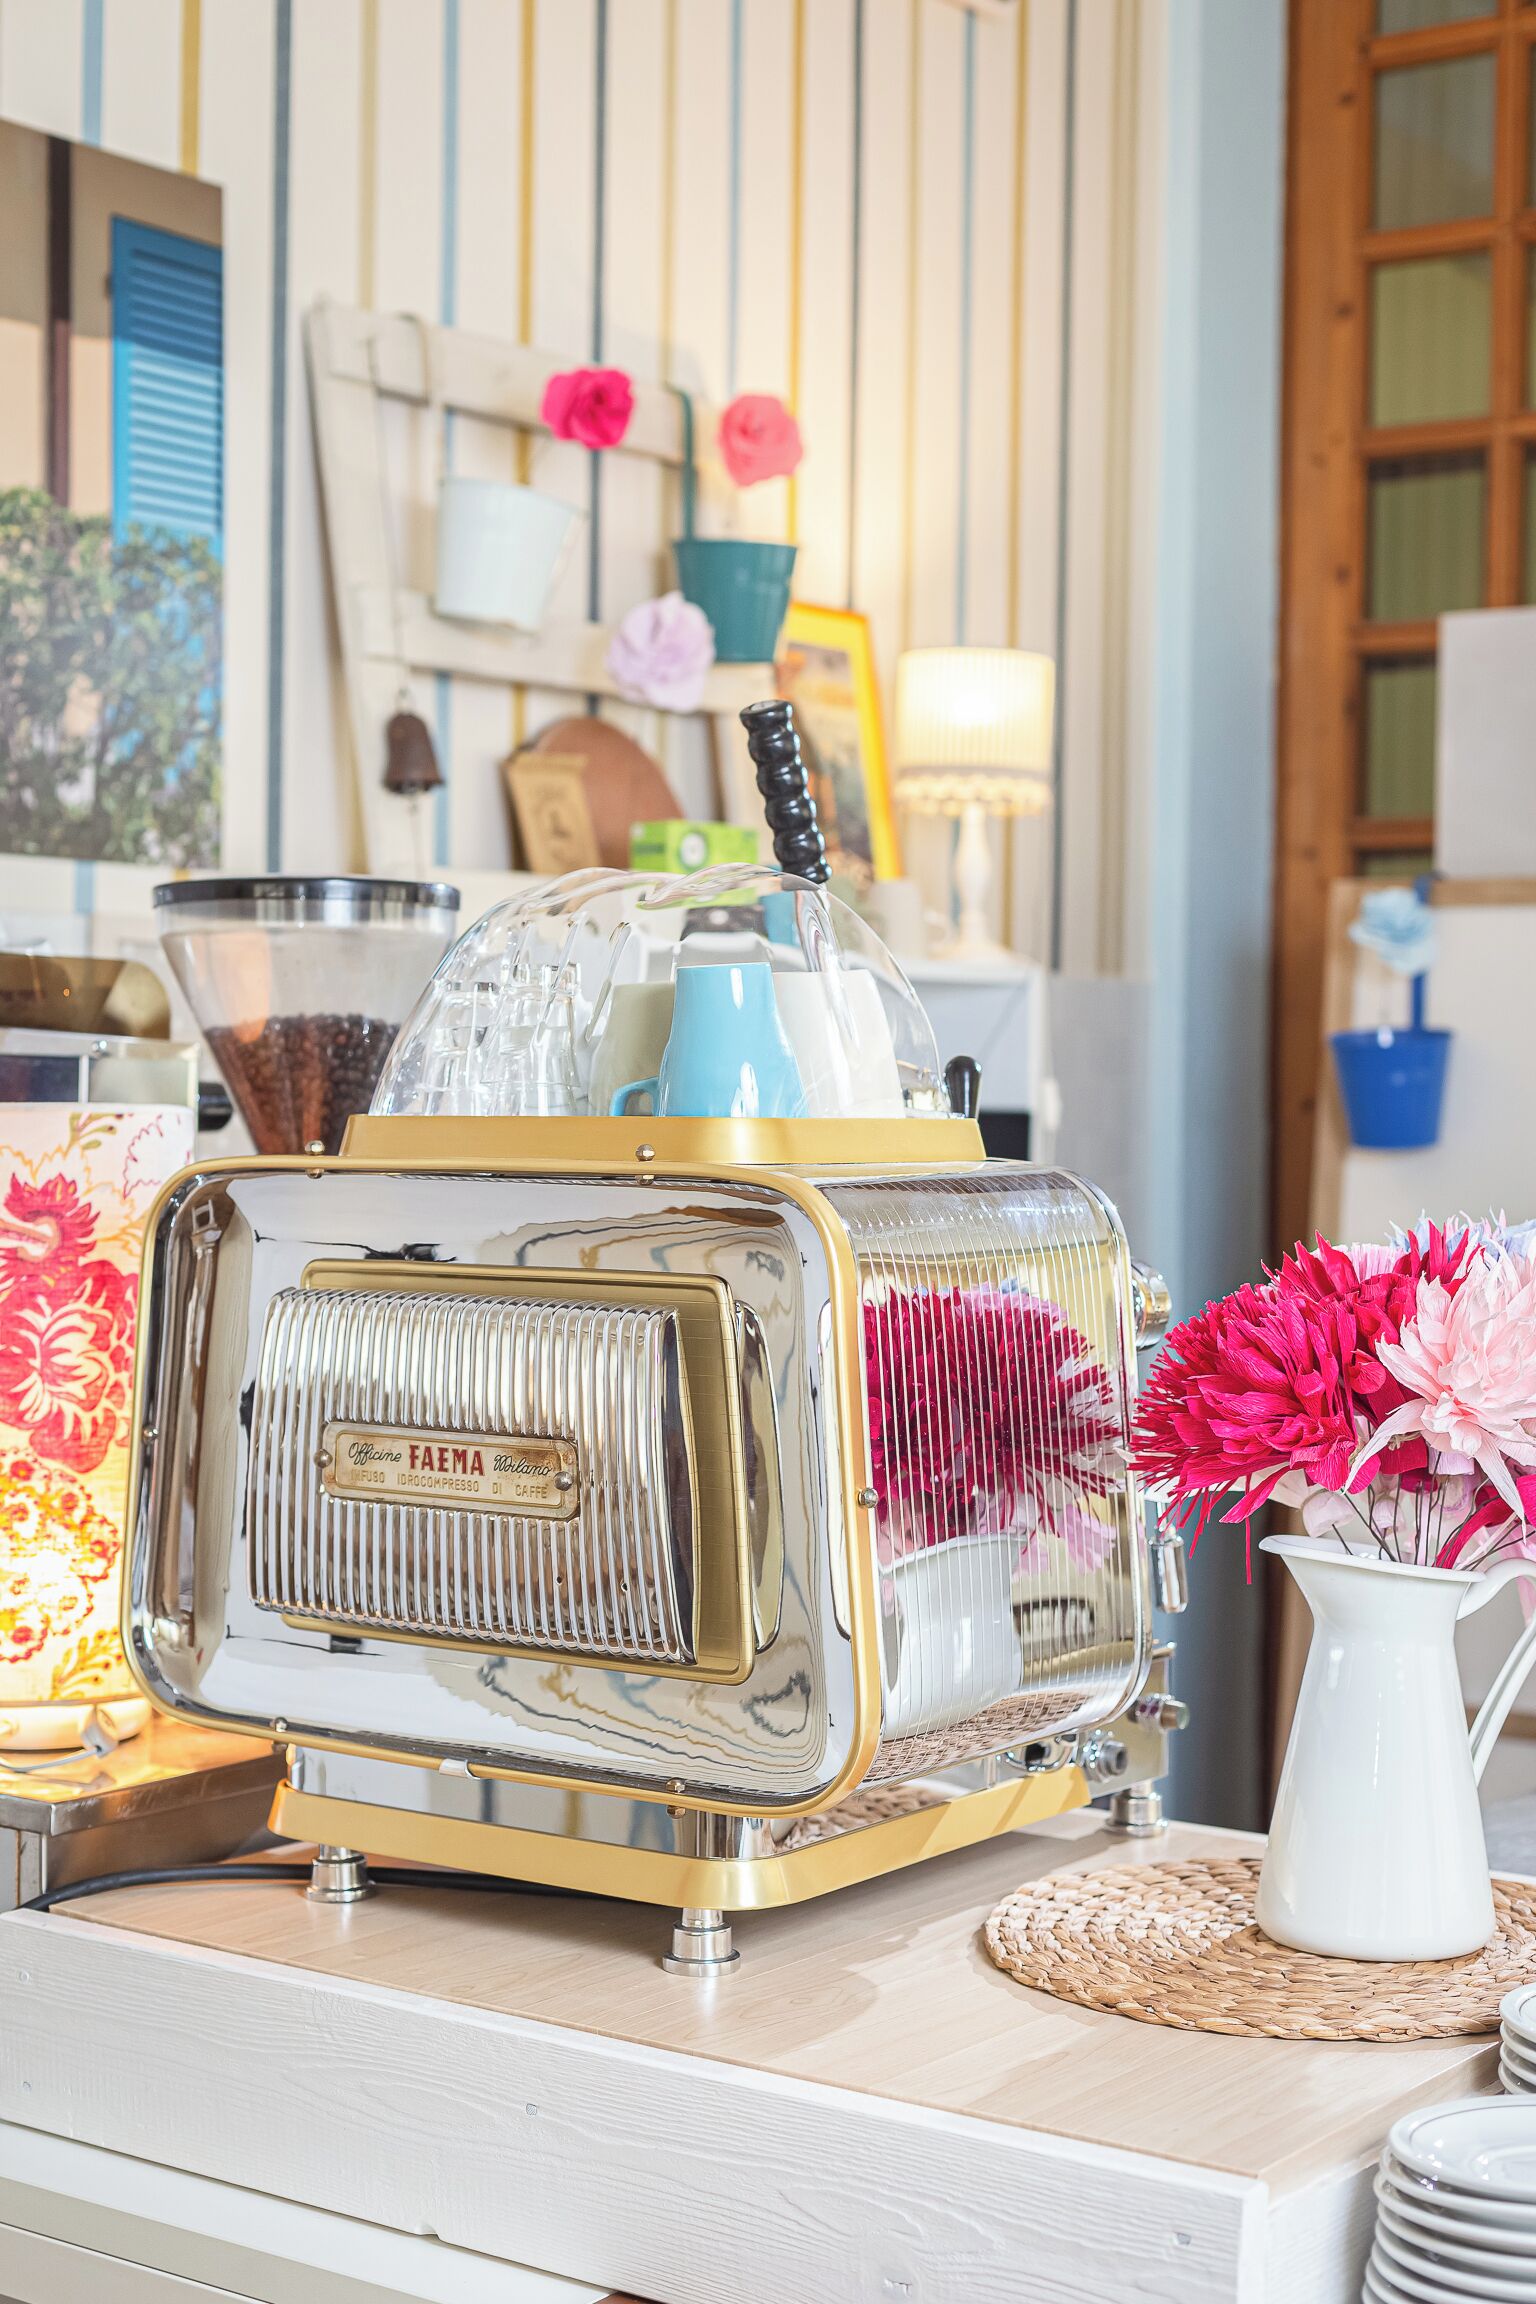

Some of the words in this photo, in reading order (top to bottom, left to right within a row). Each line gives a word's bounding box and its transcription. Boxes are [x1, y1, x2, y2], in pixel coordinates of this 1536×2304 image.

[348, 1442, 402, 1465] Officine
[409, 1444, 484, 1476] FAEMA
[493, 1454, 553, 1476] Milano
[351, 1468, 385, 1484] INFUSO
[397, 1473, 479, 1492] IDROCOMPRESSO
[492, 1482, 502, 1495] DI
